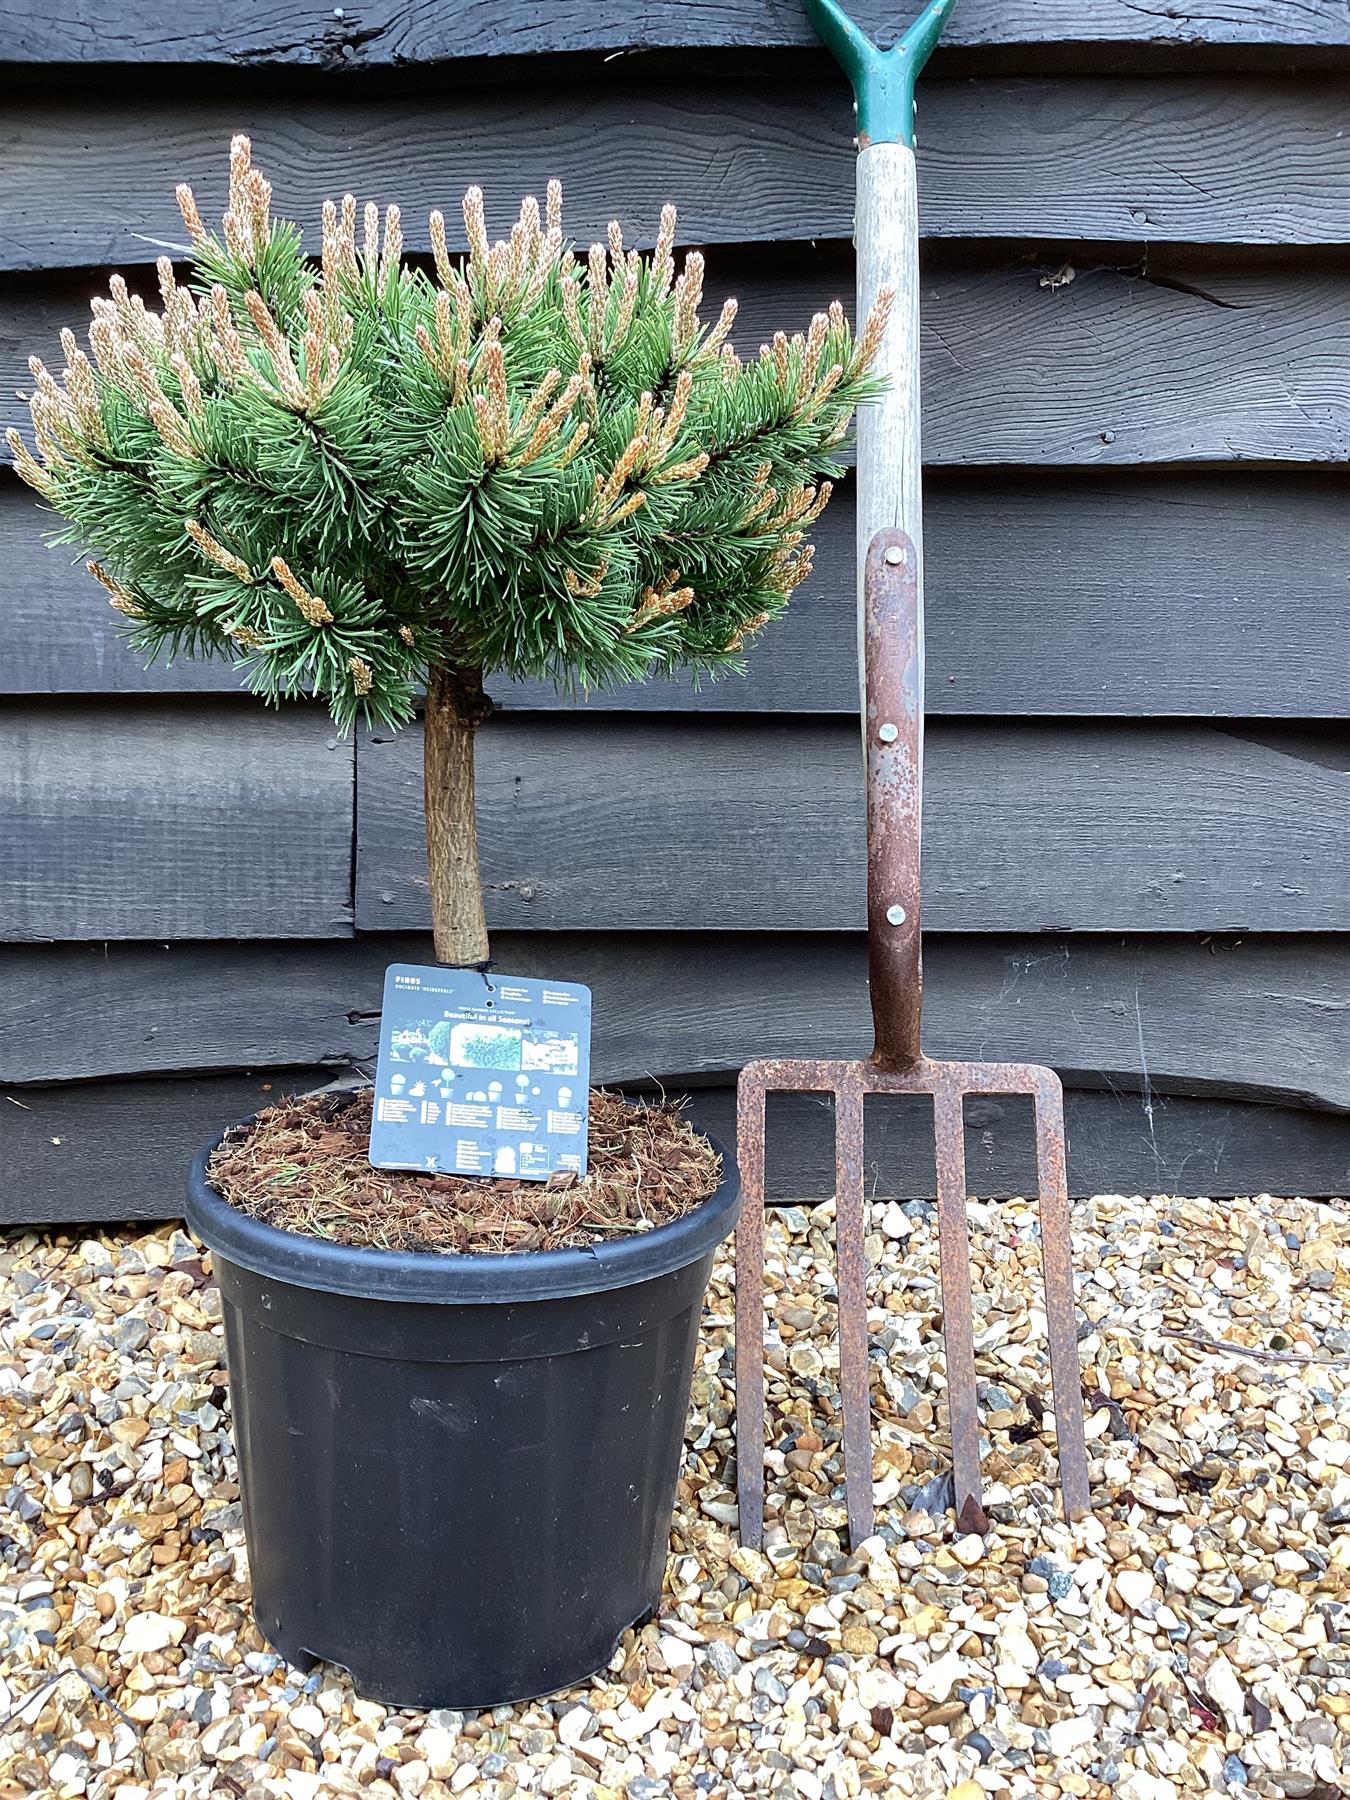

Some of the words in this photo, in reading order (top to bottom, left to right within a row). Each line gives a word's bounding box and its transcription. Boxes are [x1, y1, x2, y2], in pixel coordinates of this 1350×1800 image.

[444, 1010, 478, 1020] Beautiful
[478, 1013, 487, 1021] in
[487, 1014, 497, 1022] all
